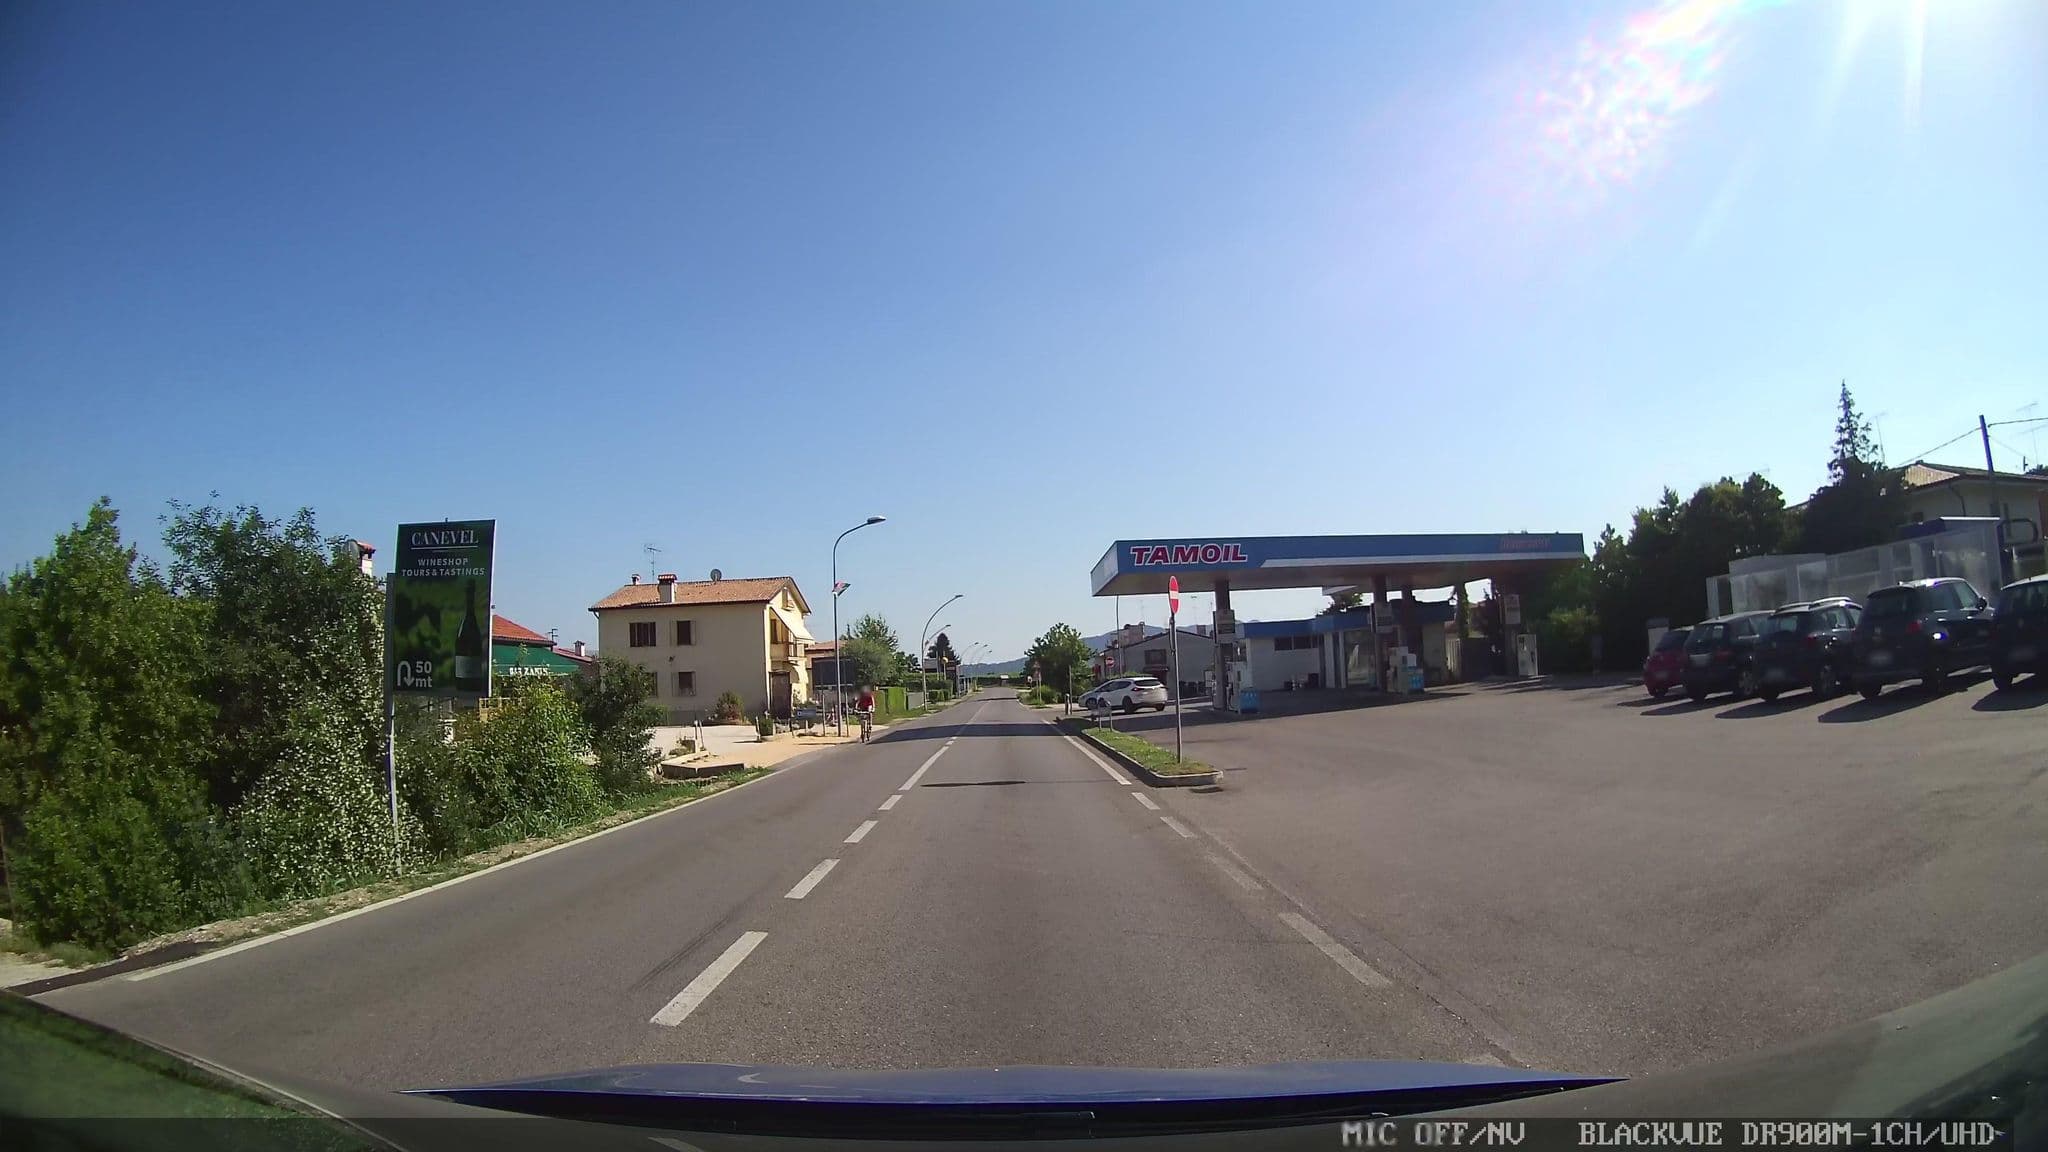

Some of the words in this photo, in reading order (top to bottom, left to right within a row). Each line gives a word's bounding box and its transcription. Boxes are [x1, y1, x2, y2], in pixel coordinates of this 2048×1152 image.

[411, 530, 479, 545] CANEVEL
[1130, 544, 1248, 566] TAMOIL
[417, 558, 469, 566] WINESHOP
[402, 568, 431, 577] TOURS
[431, 568, 437, 576] &
[439, 567, 486, 576] TASTINGS
[415, 661, 432, 674] 50
[415, 676, 433, 688] mt
